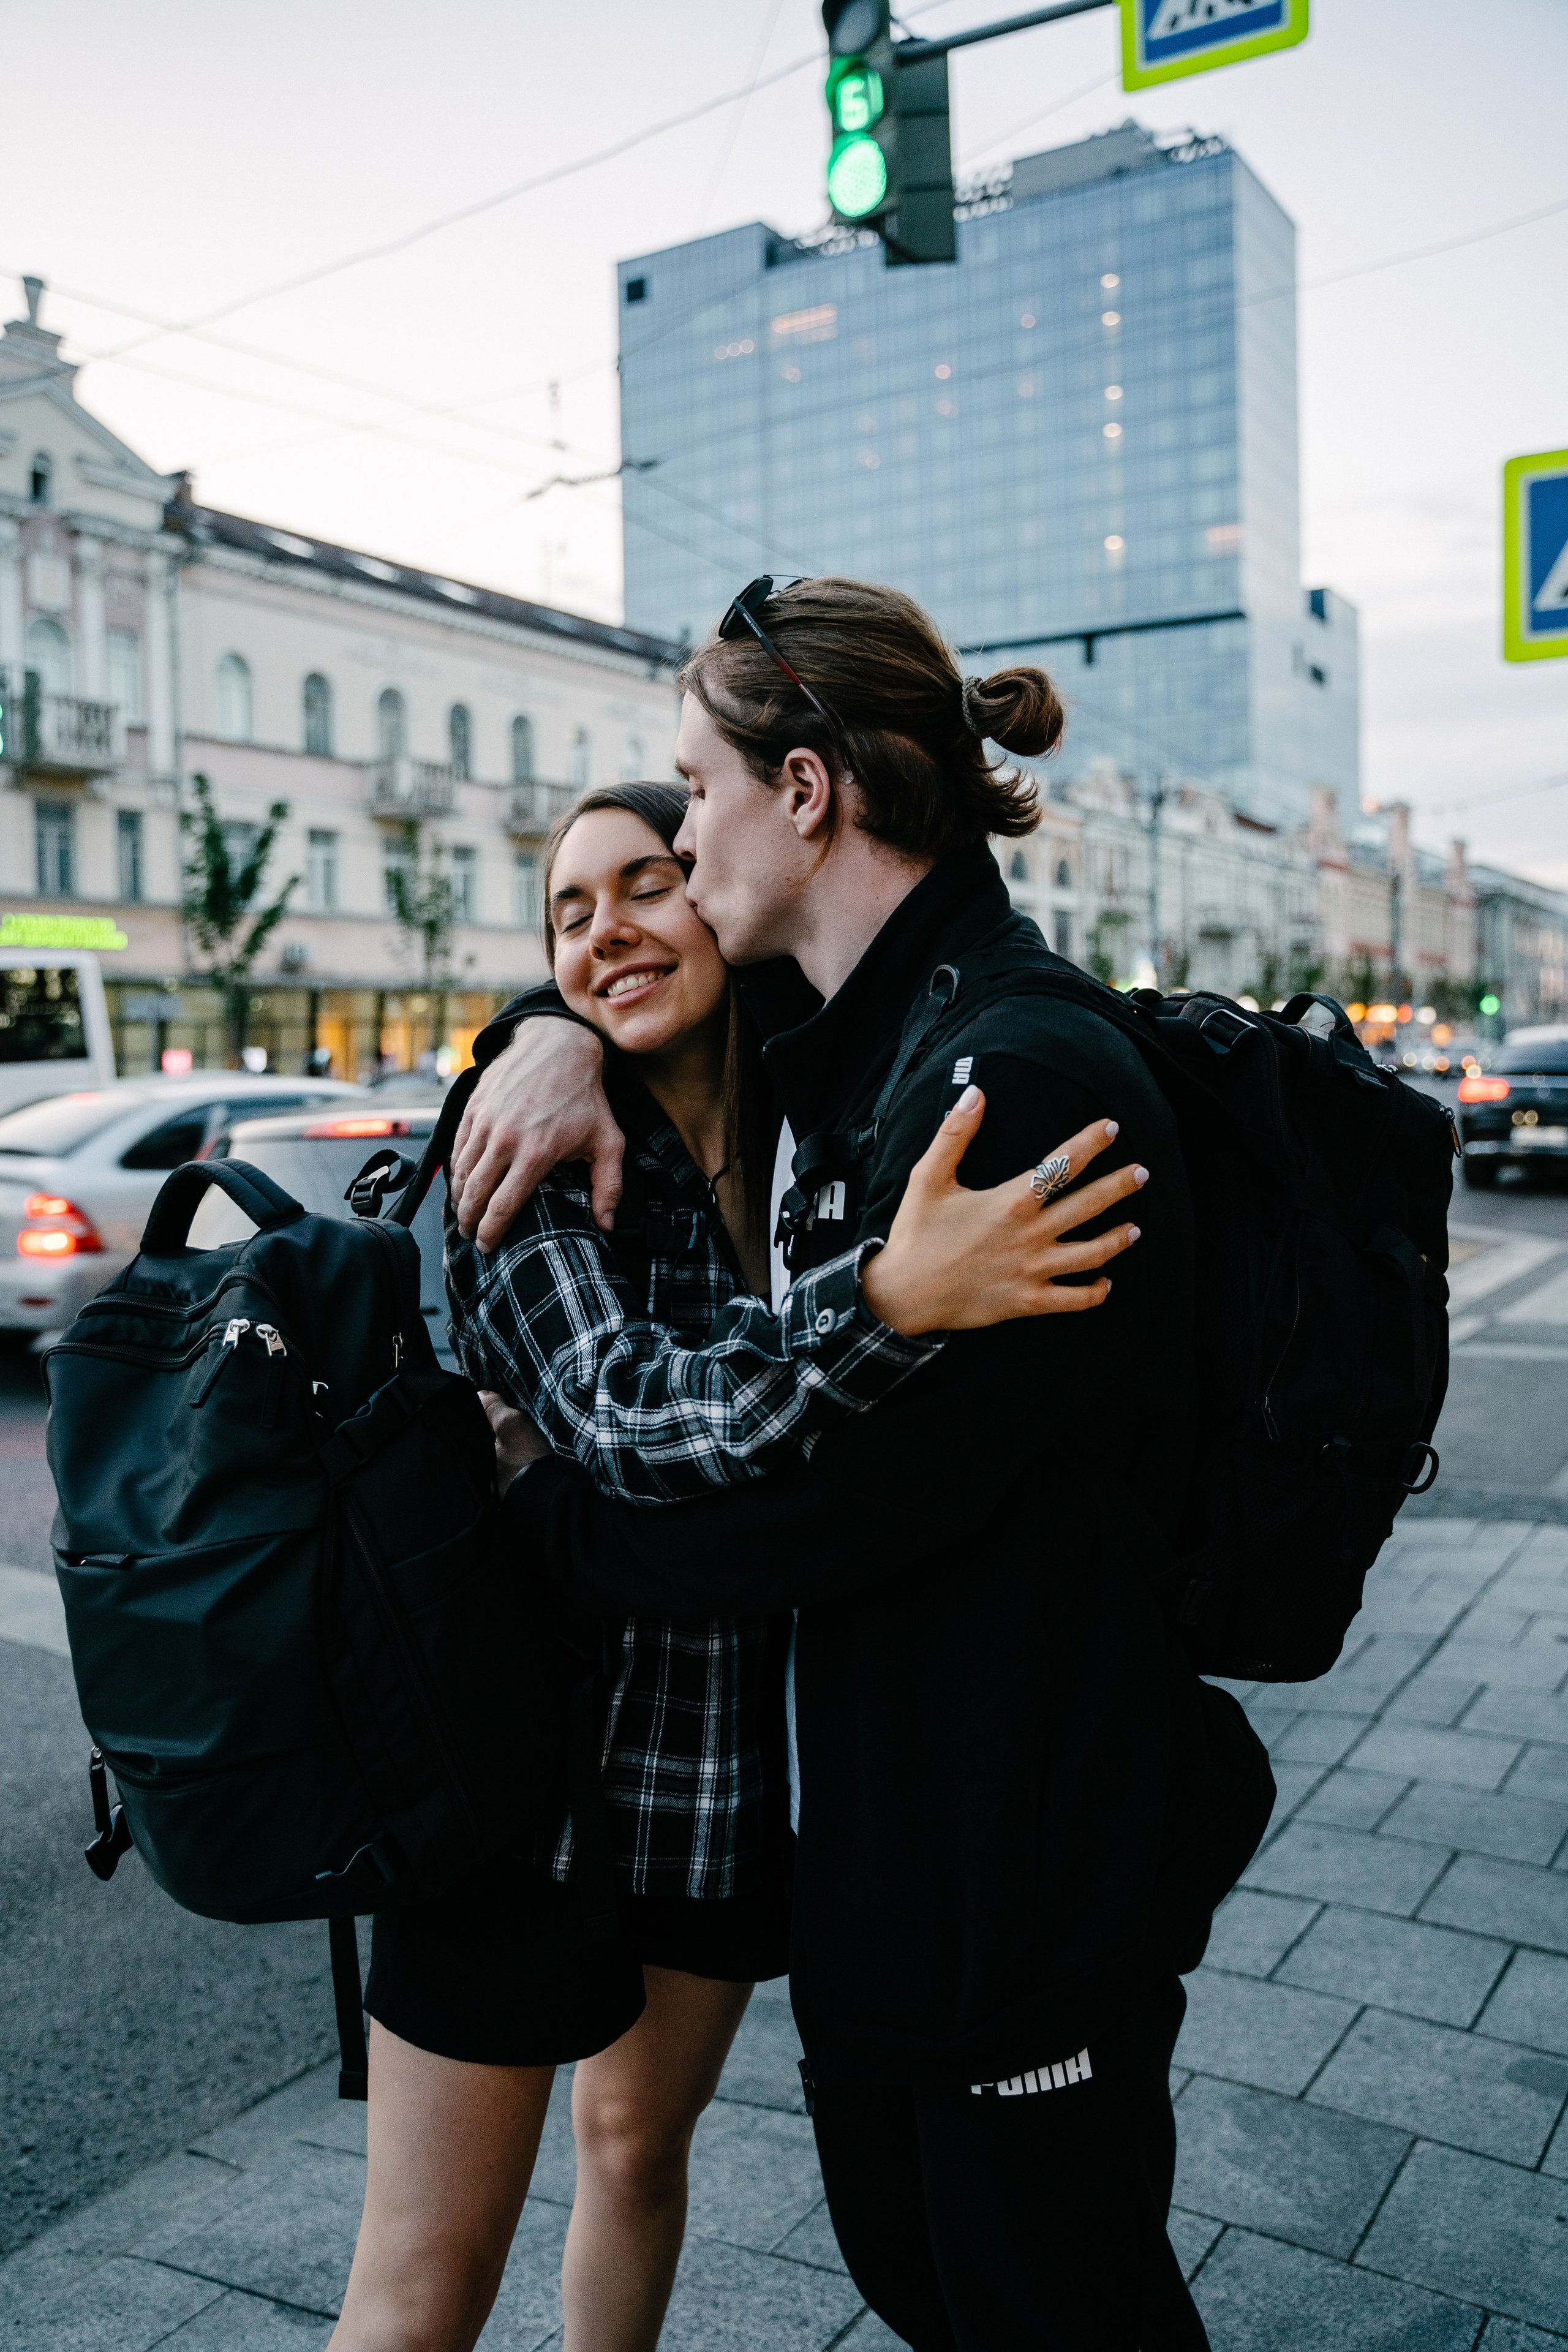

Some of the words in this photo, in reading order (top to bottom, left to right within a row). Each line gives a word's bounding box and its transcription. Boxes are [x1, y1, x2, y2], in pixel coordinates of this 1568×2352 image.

[742, 612, 752, 624] ARMANI
[750, 623, 762, 638] EXCHANGE
[971, 2047, 1093, 2096] UMA
